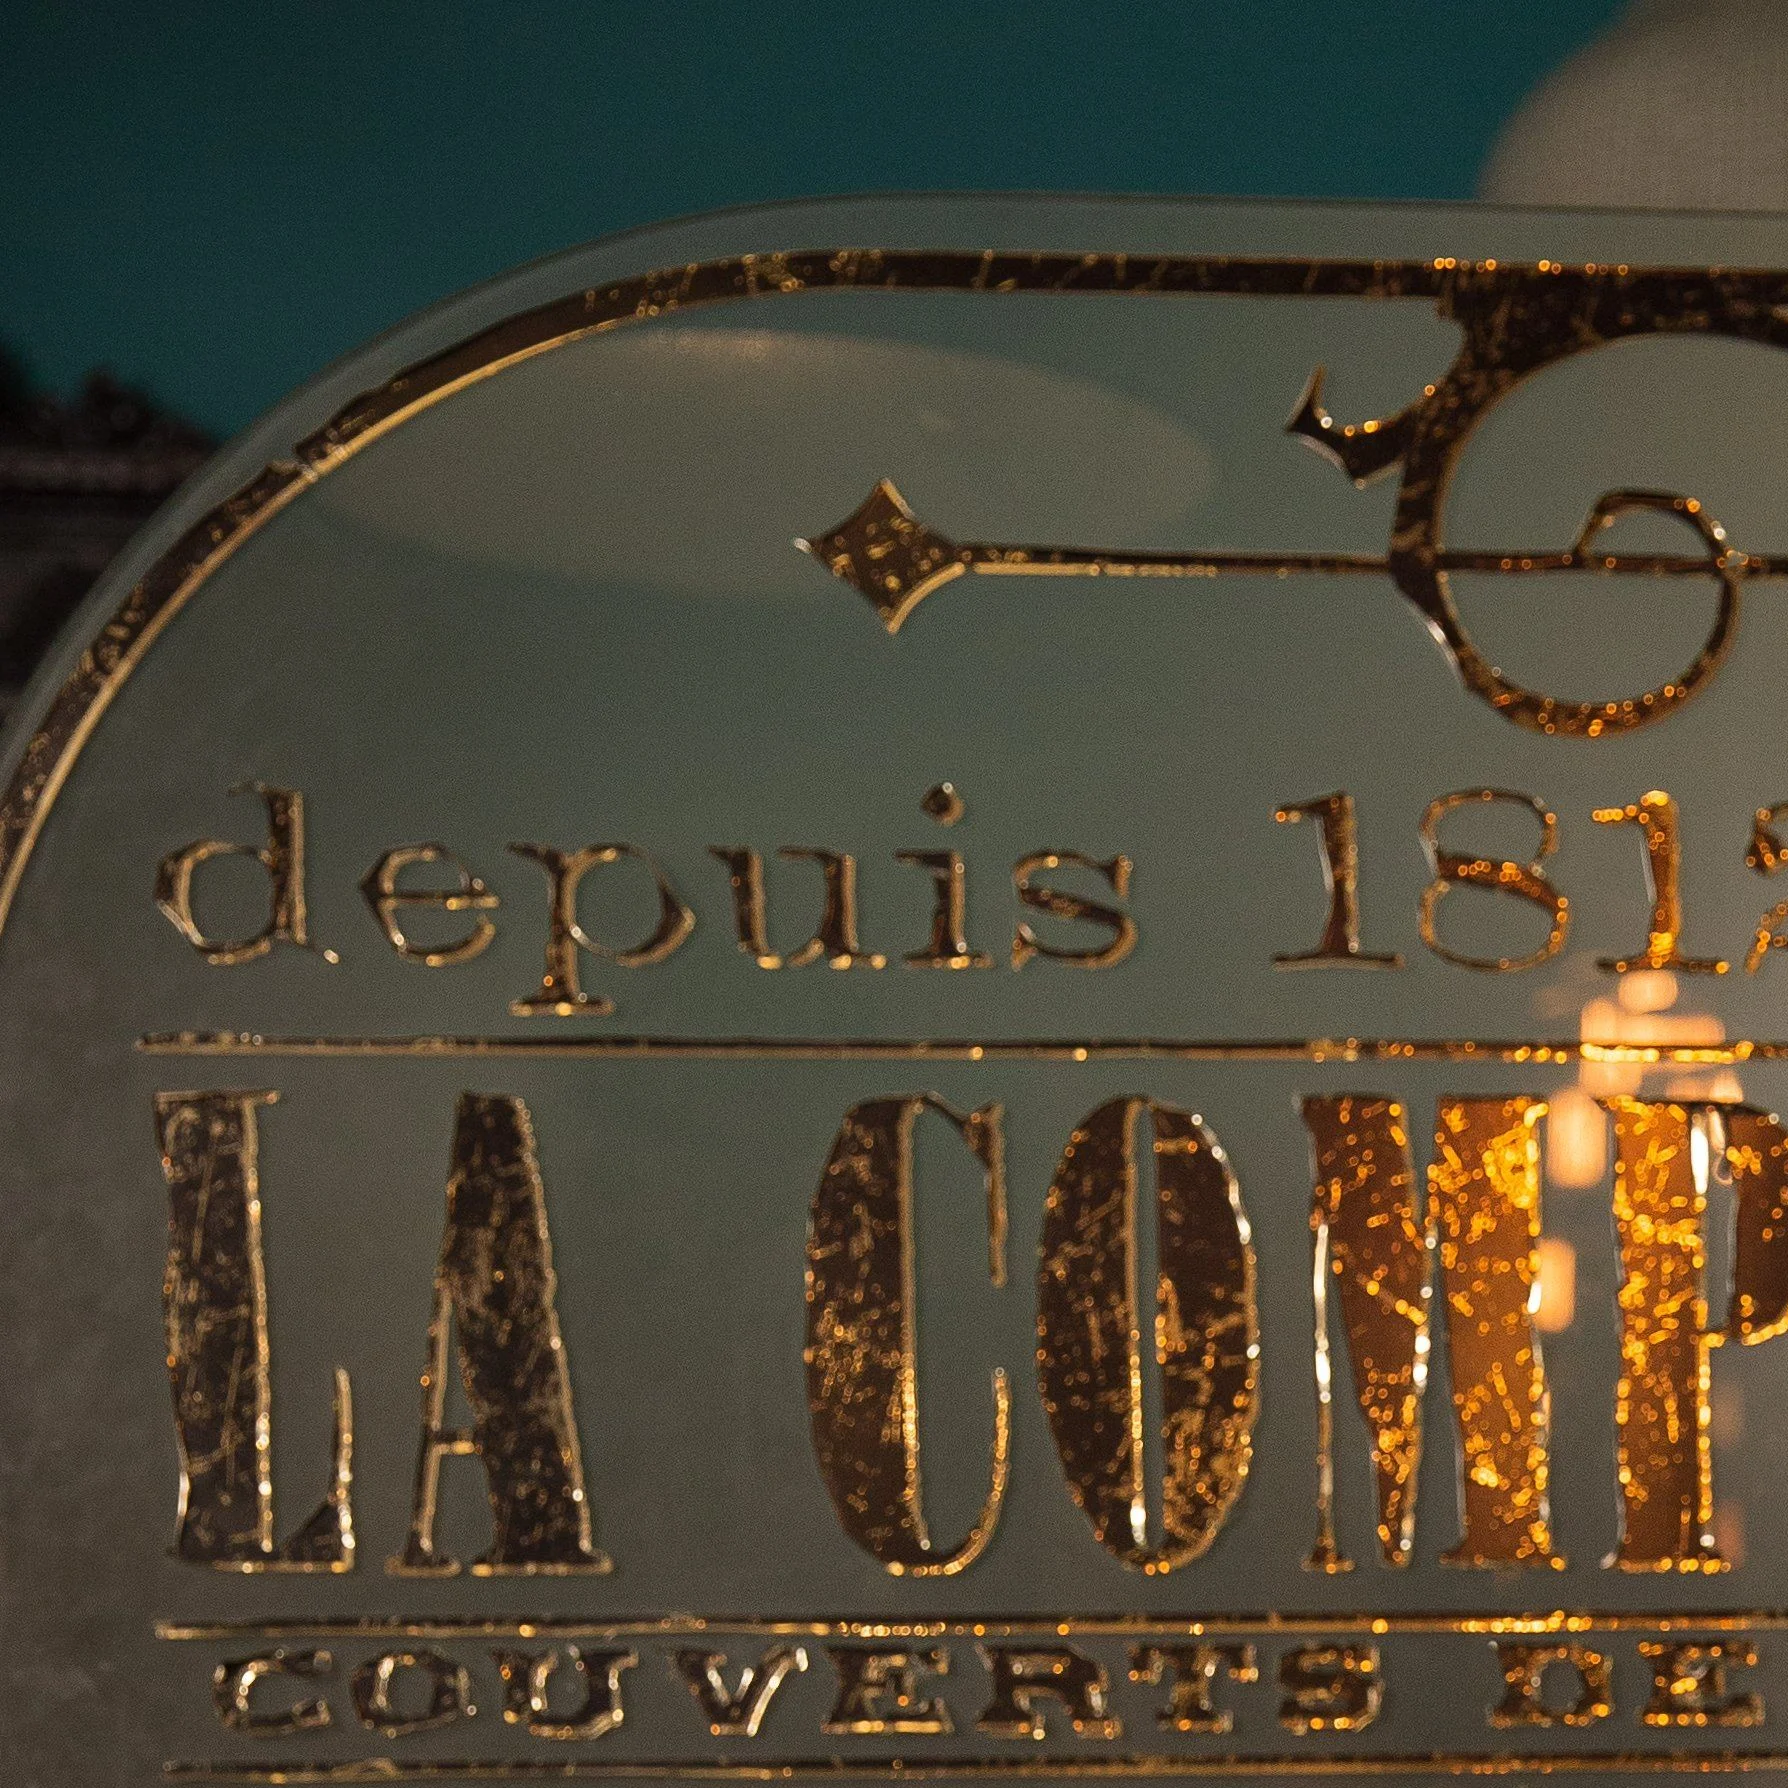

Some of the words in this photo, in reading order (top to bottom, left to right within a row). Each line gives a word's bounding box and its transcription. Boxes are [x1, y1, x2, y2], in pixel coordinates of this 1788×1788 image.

[154, 781, 1140, 1017] depuis
[151, 1087, 614, 1578] LA
[211, 1644, 1385, 1741] COUVERTS
[1484, 1638, 1765, 1730] DE
